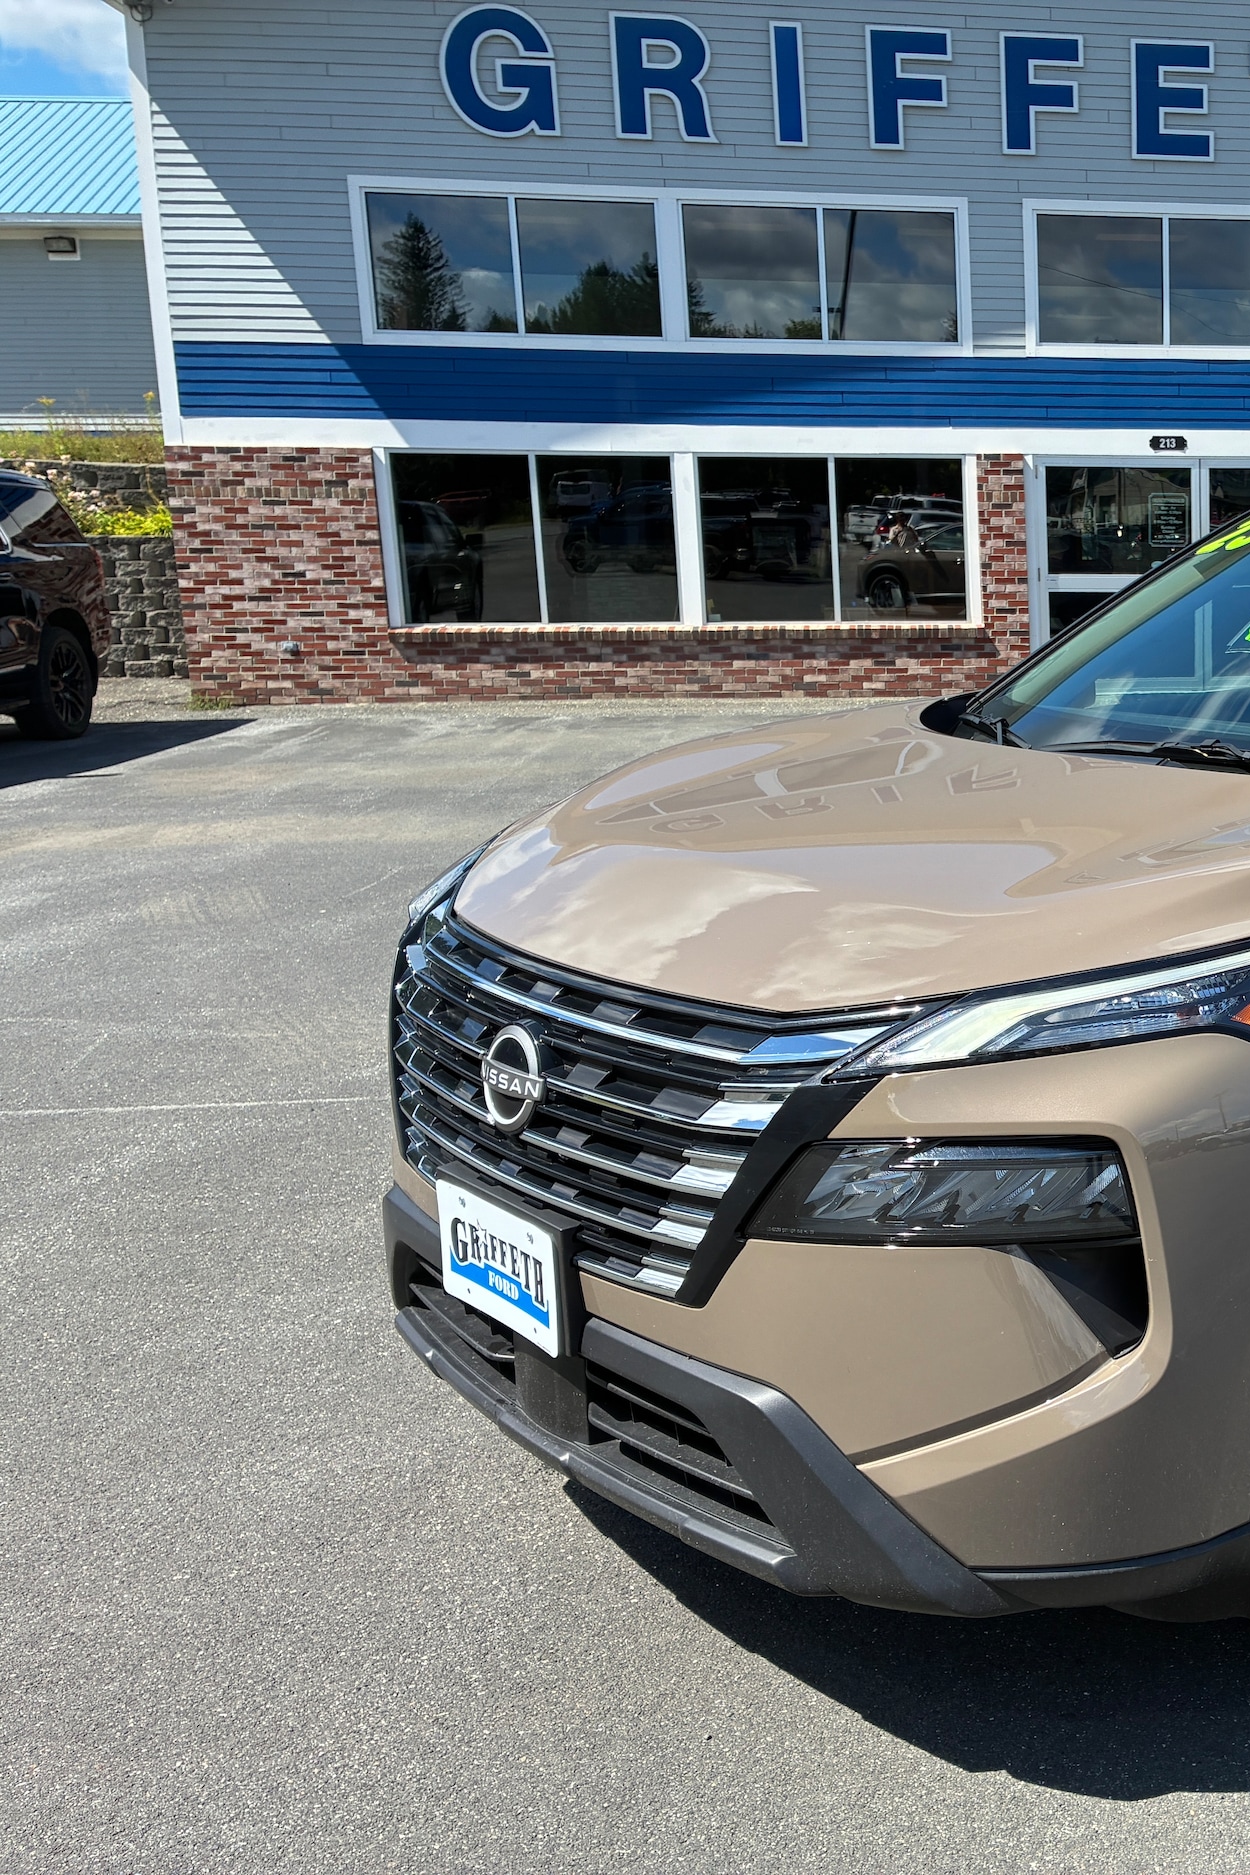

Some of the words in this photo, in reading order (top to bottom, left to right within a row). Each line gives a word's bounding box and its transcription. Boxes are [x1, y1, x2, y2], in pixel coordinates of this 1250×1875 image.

[1159, 438, 1177, 449] 213
[481, 1060, 540, 1098] NISSAN
[488, 1270, 519, 1301] FORD
